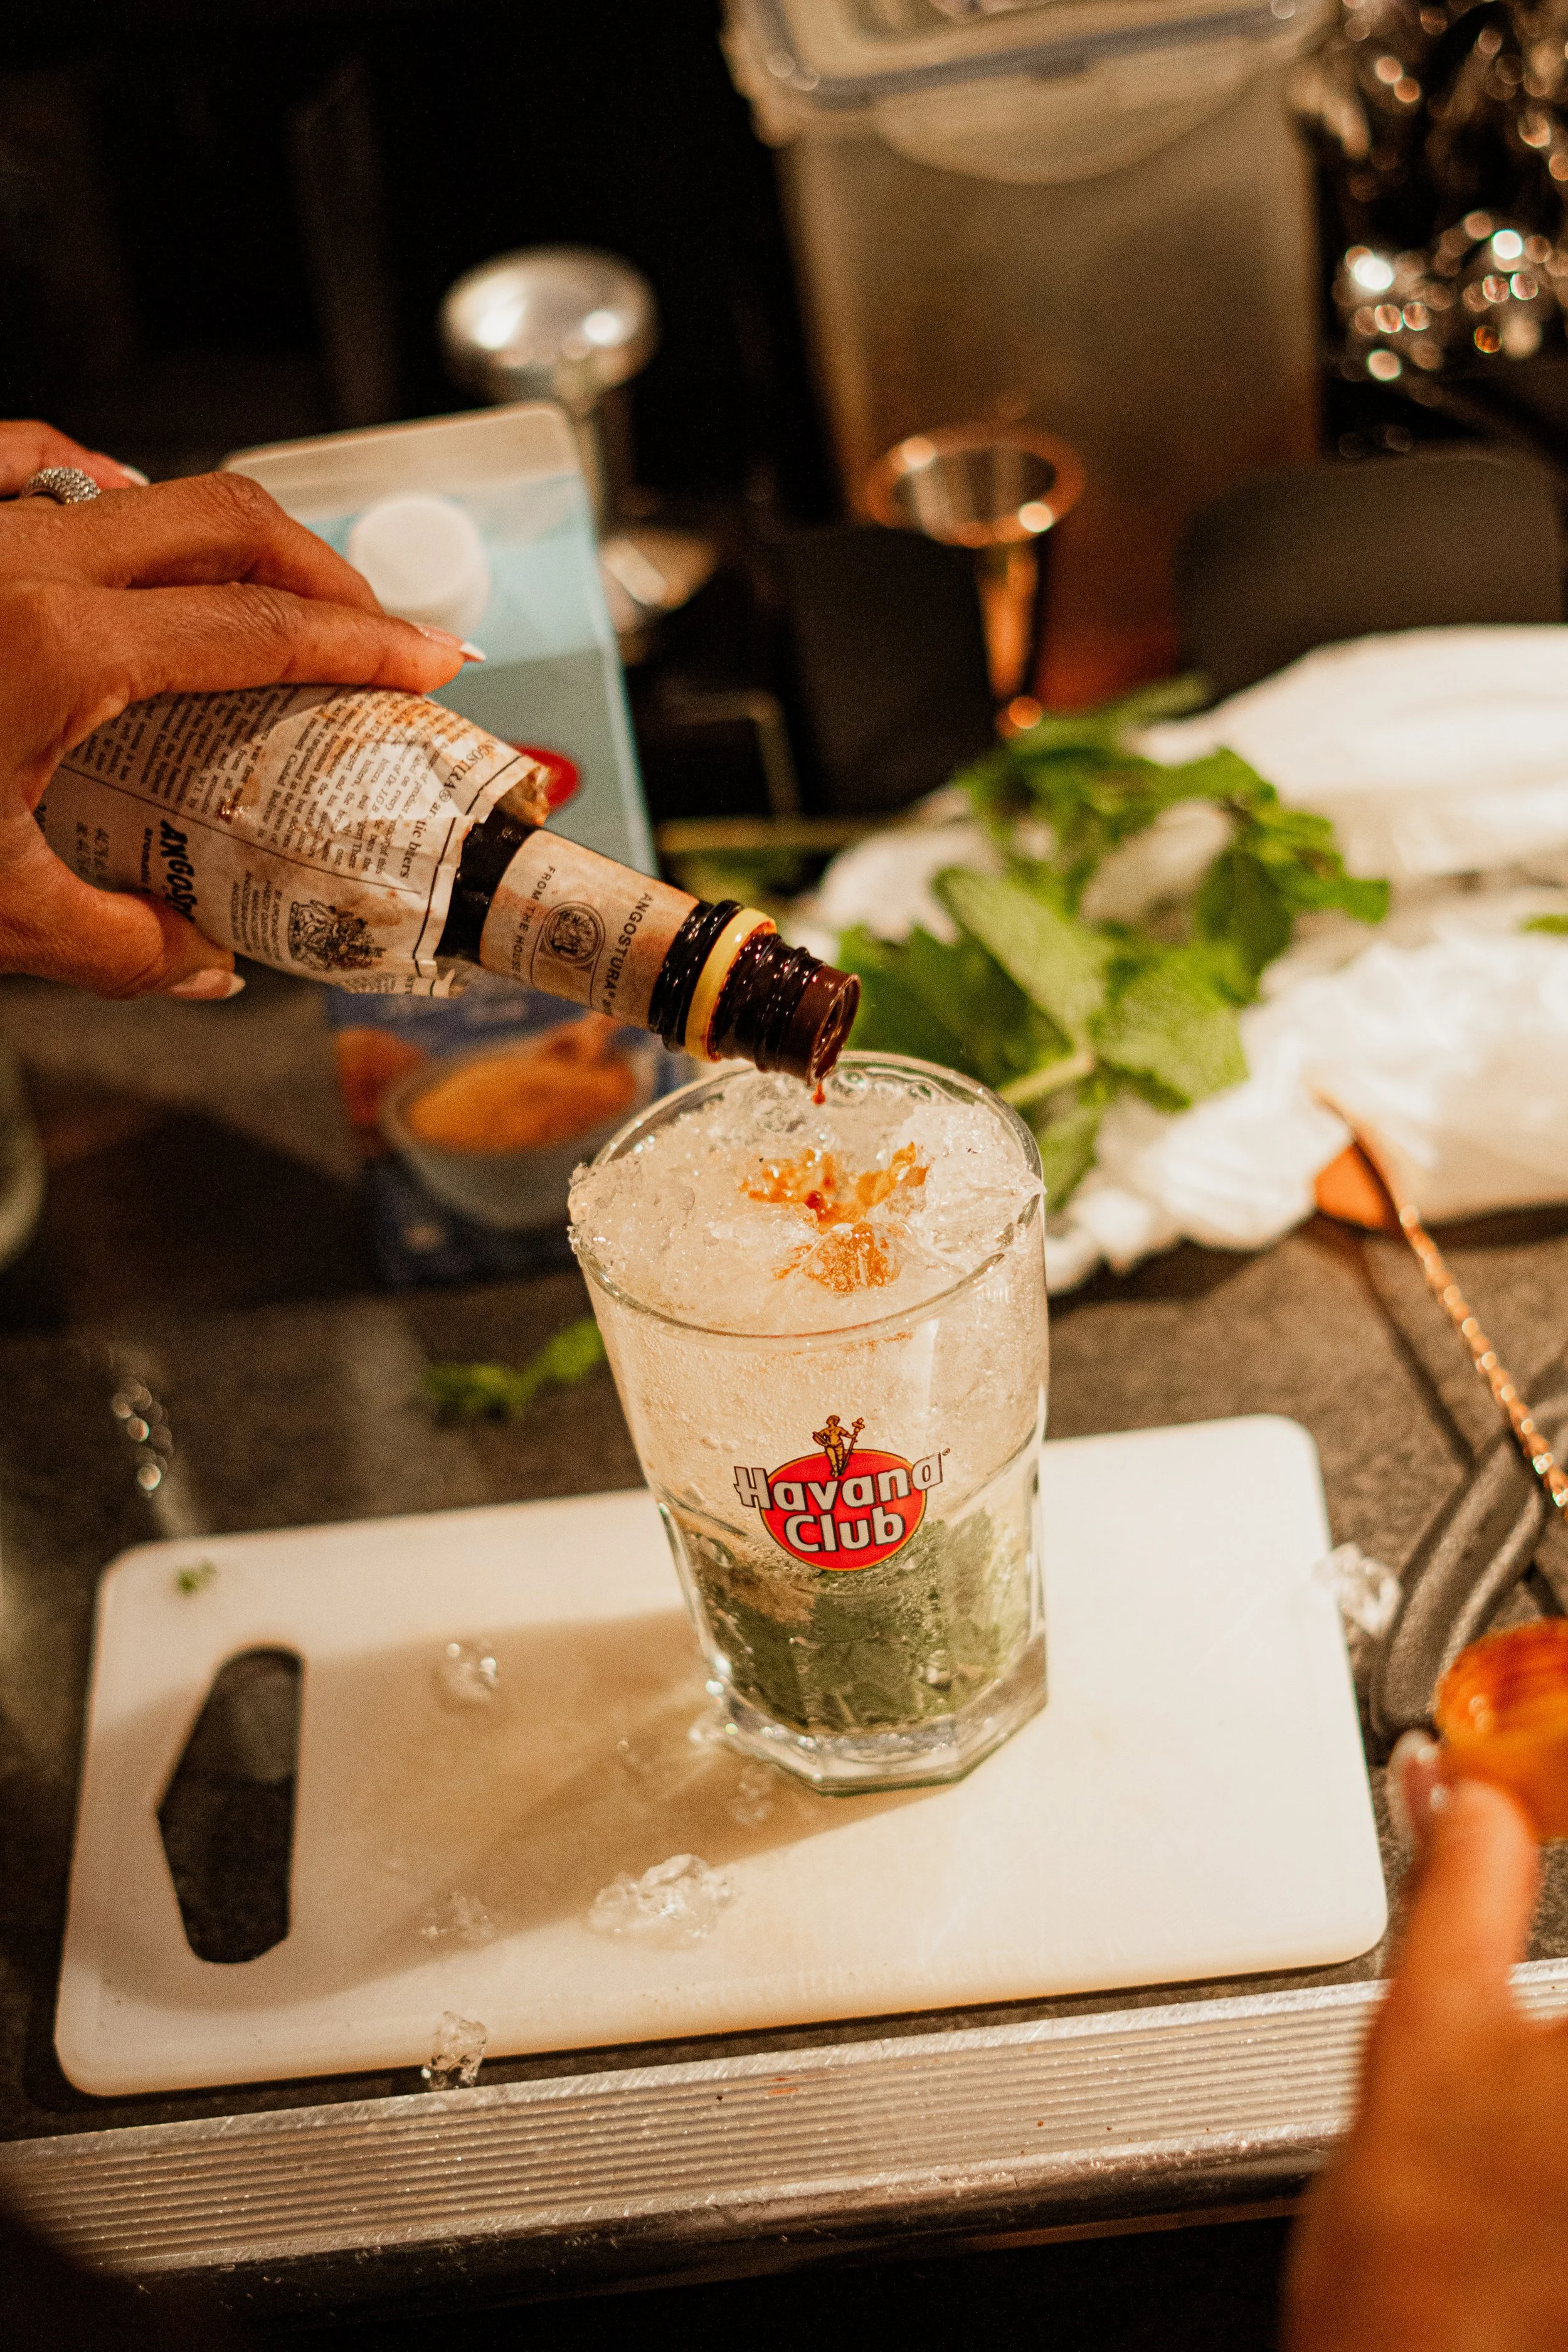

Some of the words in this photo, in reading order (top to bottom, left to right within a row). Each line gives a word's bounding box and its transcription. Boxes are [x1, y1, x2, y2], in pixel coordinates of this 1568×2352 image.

[231, 748, 248, 772] from
[317, 781, 329, 797] the
[335, 775, 348, 791] and
[283, 792, 295, 807] the
[327, 794, 339, 808] his
[343, 791, 356, 807] the
[357, 793, 370, 810] but
[385, 789, 402, 813] every
[304, 800, 319, 827] world
[334, 847, 344, 866] one
[531, 865, 555, 901] FROM
[518, 904, 536, 931] THE
[512, 934, 525, 972] HOUSE
[784, 1507, 906, 1552] Club
